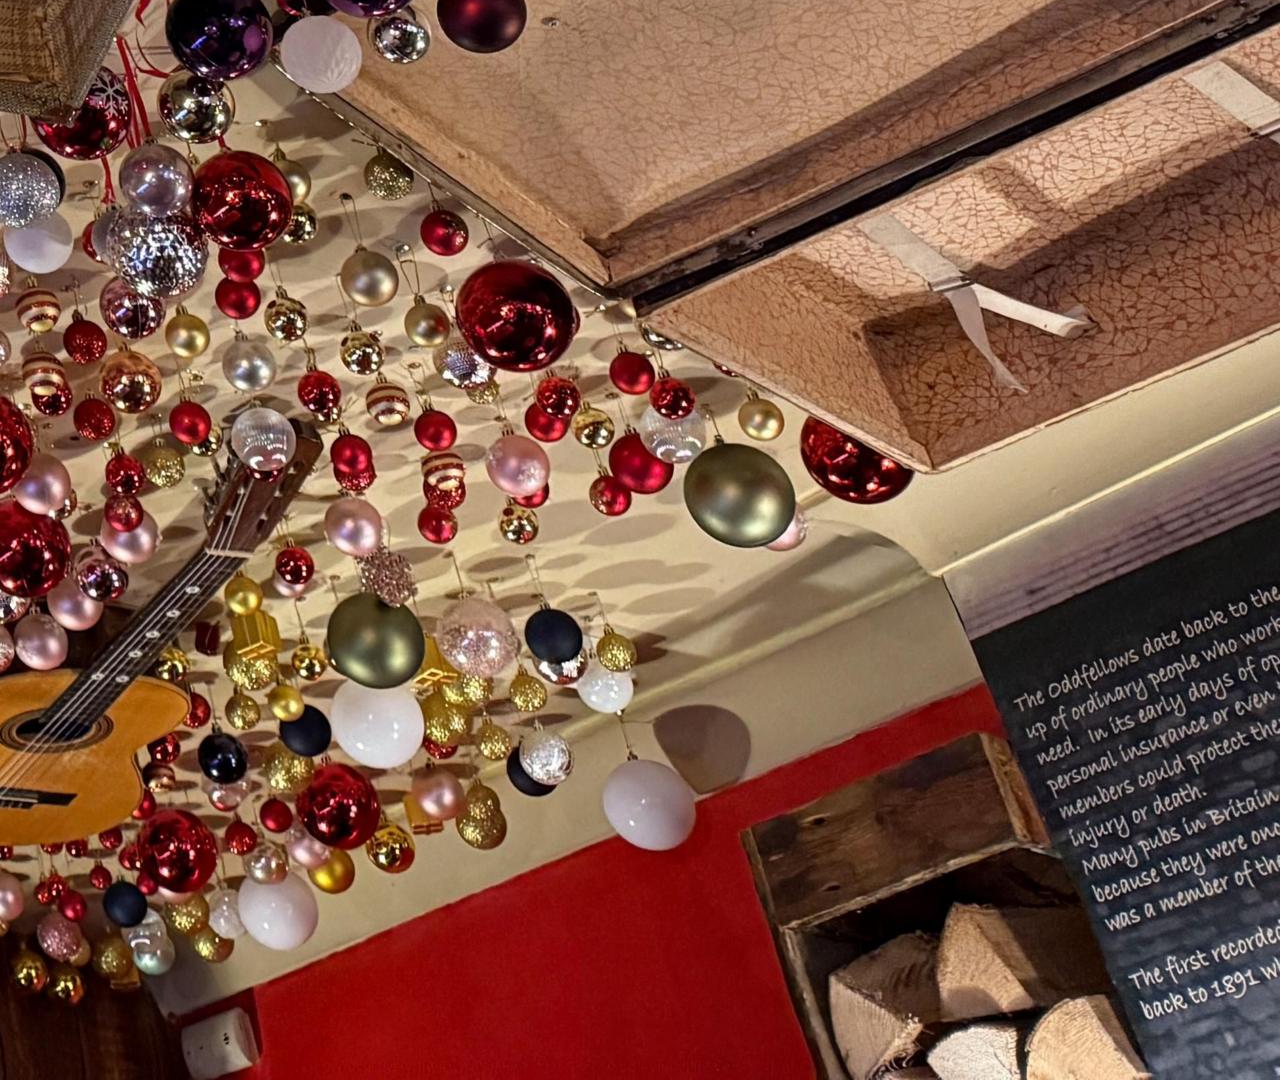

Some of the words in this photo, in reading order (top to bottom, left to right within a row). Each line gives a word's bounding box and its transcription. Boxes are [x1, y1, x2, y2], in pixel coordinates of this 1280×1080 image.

[1013, 690, 1045, 712] The
[1048, 648, 1140, 699] Oddfellows
[1143, 629, 1181, 656] date
[1181, 610, 1228, 638] back
[1228, 601, 1248, 618] to
[1250, 585, 1280, 608] the
[1026, 722, 1047, 741] up
[1051, 705, 1067, 730] of
[1072, 678, 1148, 720] ordinary
[1147, 653, 1201, 692] people
[1201, 637, 1238, 662] who
[1240, 616, 1280, 645] work
[1036, 736, 1080, 765] need.
[1088, 728, 1109, 743] In
[1109, 716, 1135, 735] its
[1139, 694, 1187, 717] early
[1189, 673, 1234, 702] days
[1238, 656, 1257, 682] of
[1047, 751, 1118, 799] personal
[1119, 716, 1209, 762] insurance
[1213, 707, 1229, 725] or
[1234, 691, 1275, 716] even
[1059, 779, 1135, 820] members
[1138, 757, 1185, 788] could
[1187, 731, 1250, 774] protect
[1250, 718, 1280, 741] the
[1069, 814, 1130, 848] injury
[1132, 807, 1148, 824] or
[1153, 782, 1207, 815] death.
[1082, 845, 1138, 875] Many
[1139, 827, 1182, 861] pubs
[1183, 817, 1207, 836] in
[1207, 789, 1279, 826] Britain
[1092, 867, 1160, 902] because
[1161, 852, 1206, 876] they
[1206, 834, 1248, 861] were
[1105, 909, 1141, 932] was
[1144, 902, 1156, 918] a
[1159, 876, 1229, 912] member
[1235, 860, 1255, 888] of
[1128, 968, 1164, 990] The
[1166, 950, 1210, 984] first
[1140, 993, 1188, 1020] back
[1188, 987, 1207, 1004] to
[1211, 970, 1260, 999] 1891
